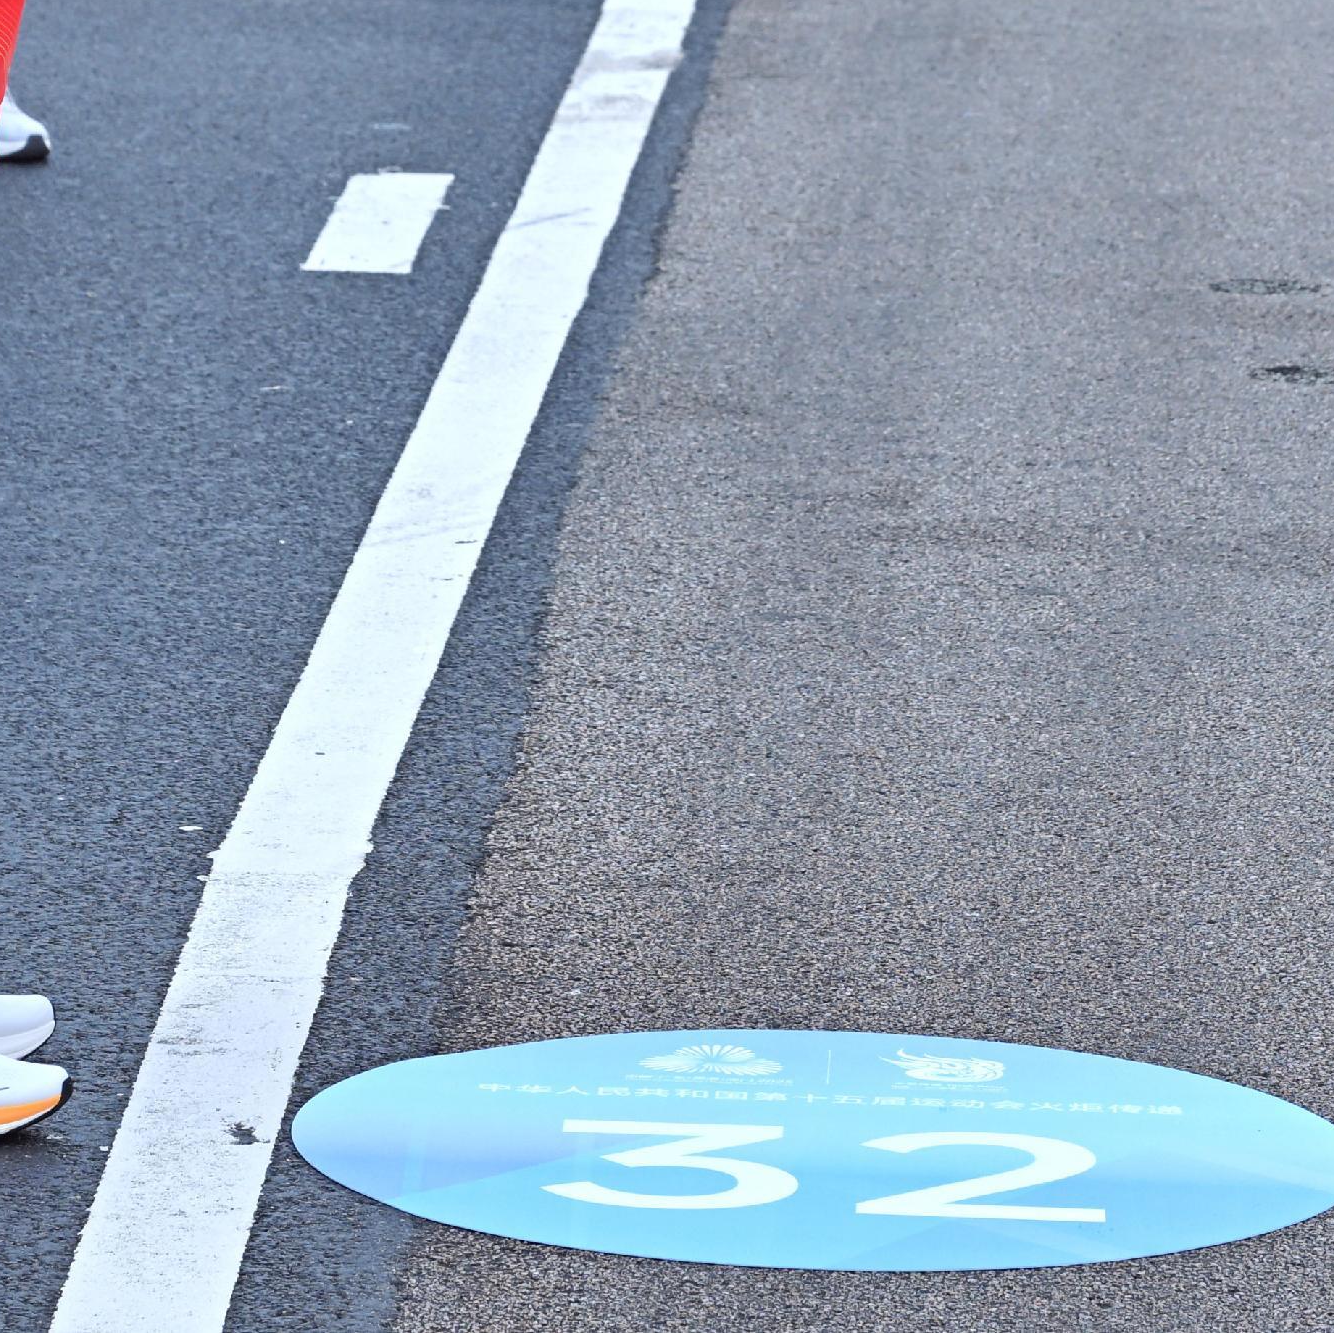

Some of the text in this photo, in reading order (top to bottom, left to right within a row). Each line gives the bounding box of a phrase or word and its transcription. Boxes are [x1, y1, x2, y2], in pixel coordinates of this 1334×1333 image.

[478, 1082, 1183, 1116] 中华人民共和国第十五届运动会火炬传递
[540, 1118, 1106, 1222] 32
